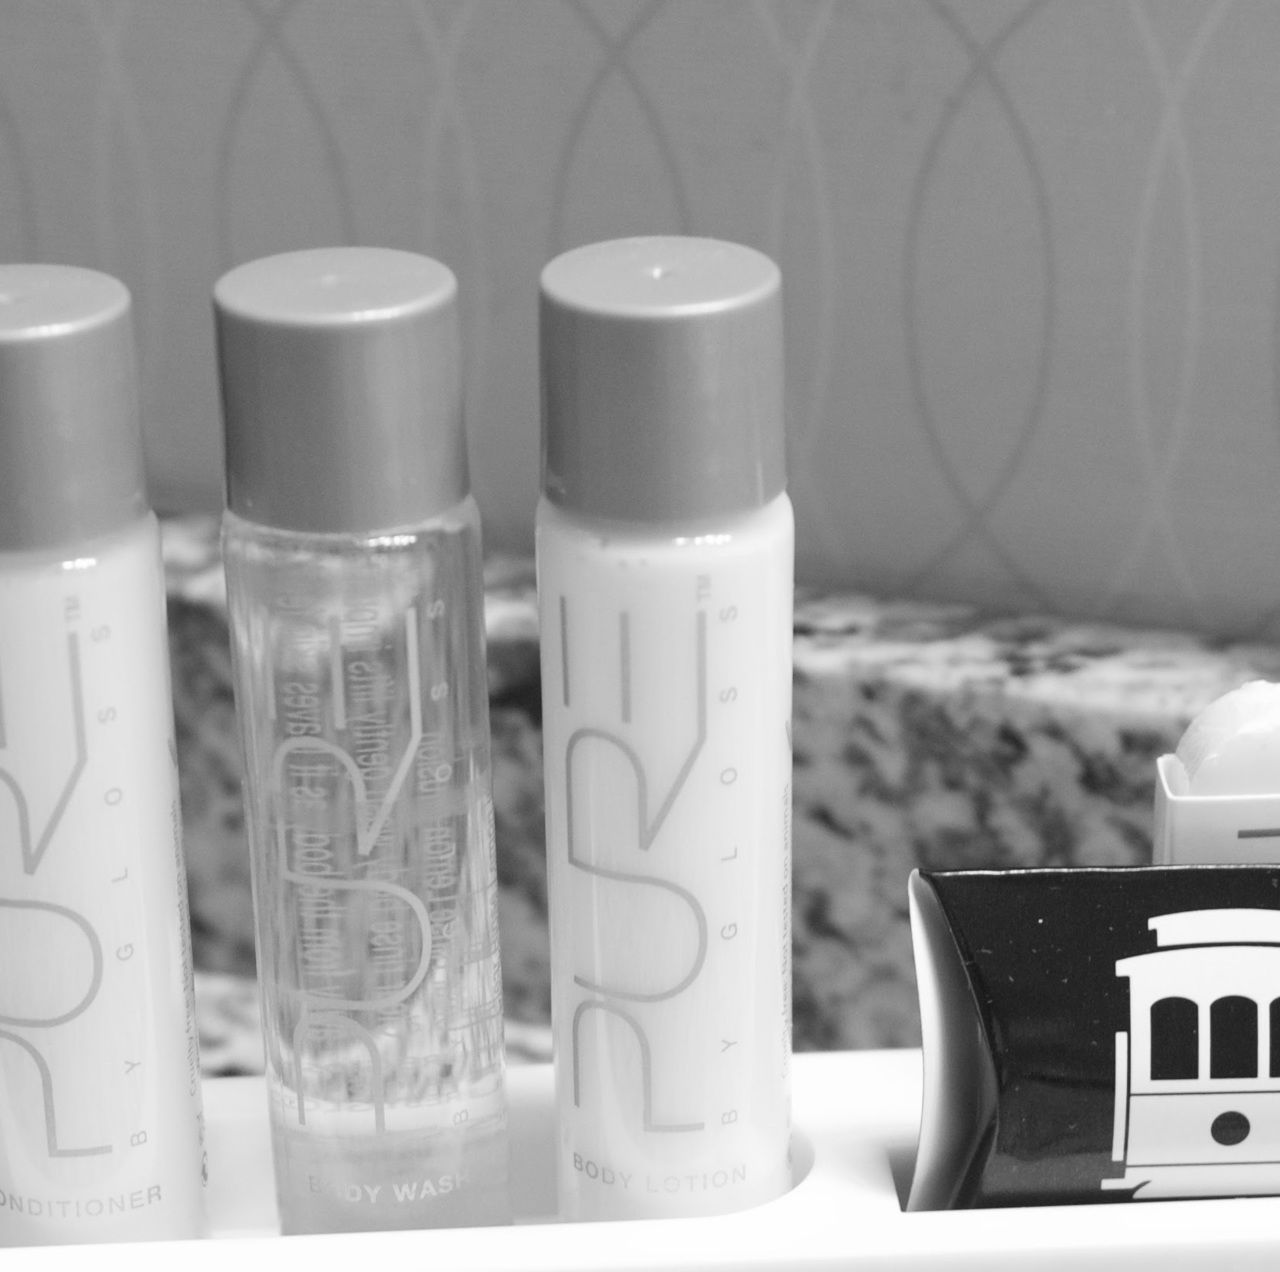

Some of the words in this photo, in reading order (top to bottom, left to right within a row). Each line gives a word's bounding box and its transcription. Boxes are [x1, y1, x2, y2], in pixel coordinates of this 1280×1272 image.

[90, 624, 136, 963] GLOSS
[561, 595, 707, 1132] PURE
[718, 604, 738, 941] GLOSS
[124, 1059, 149, 1147] BY
[573, 1151, 632, 1189] BODY
[645, 1163, 747, 1193] LOTION
[719, 1036, 739, 1125] BY
